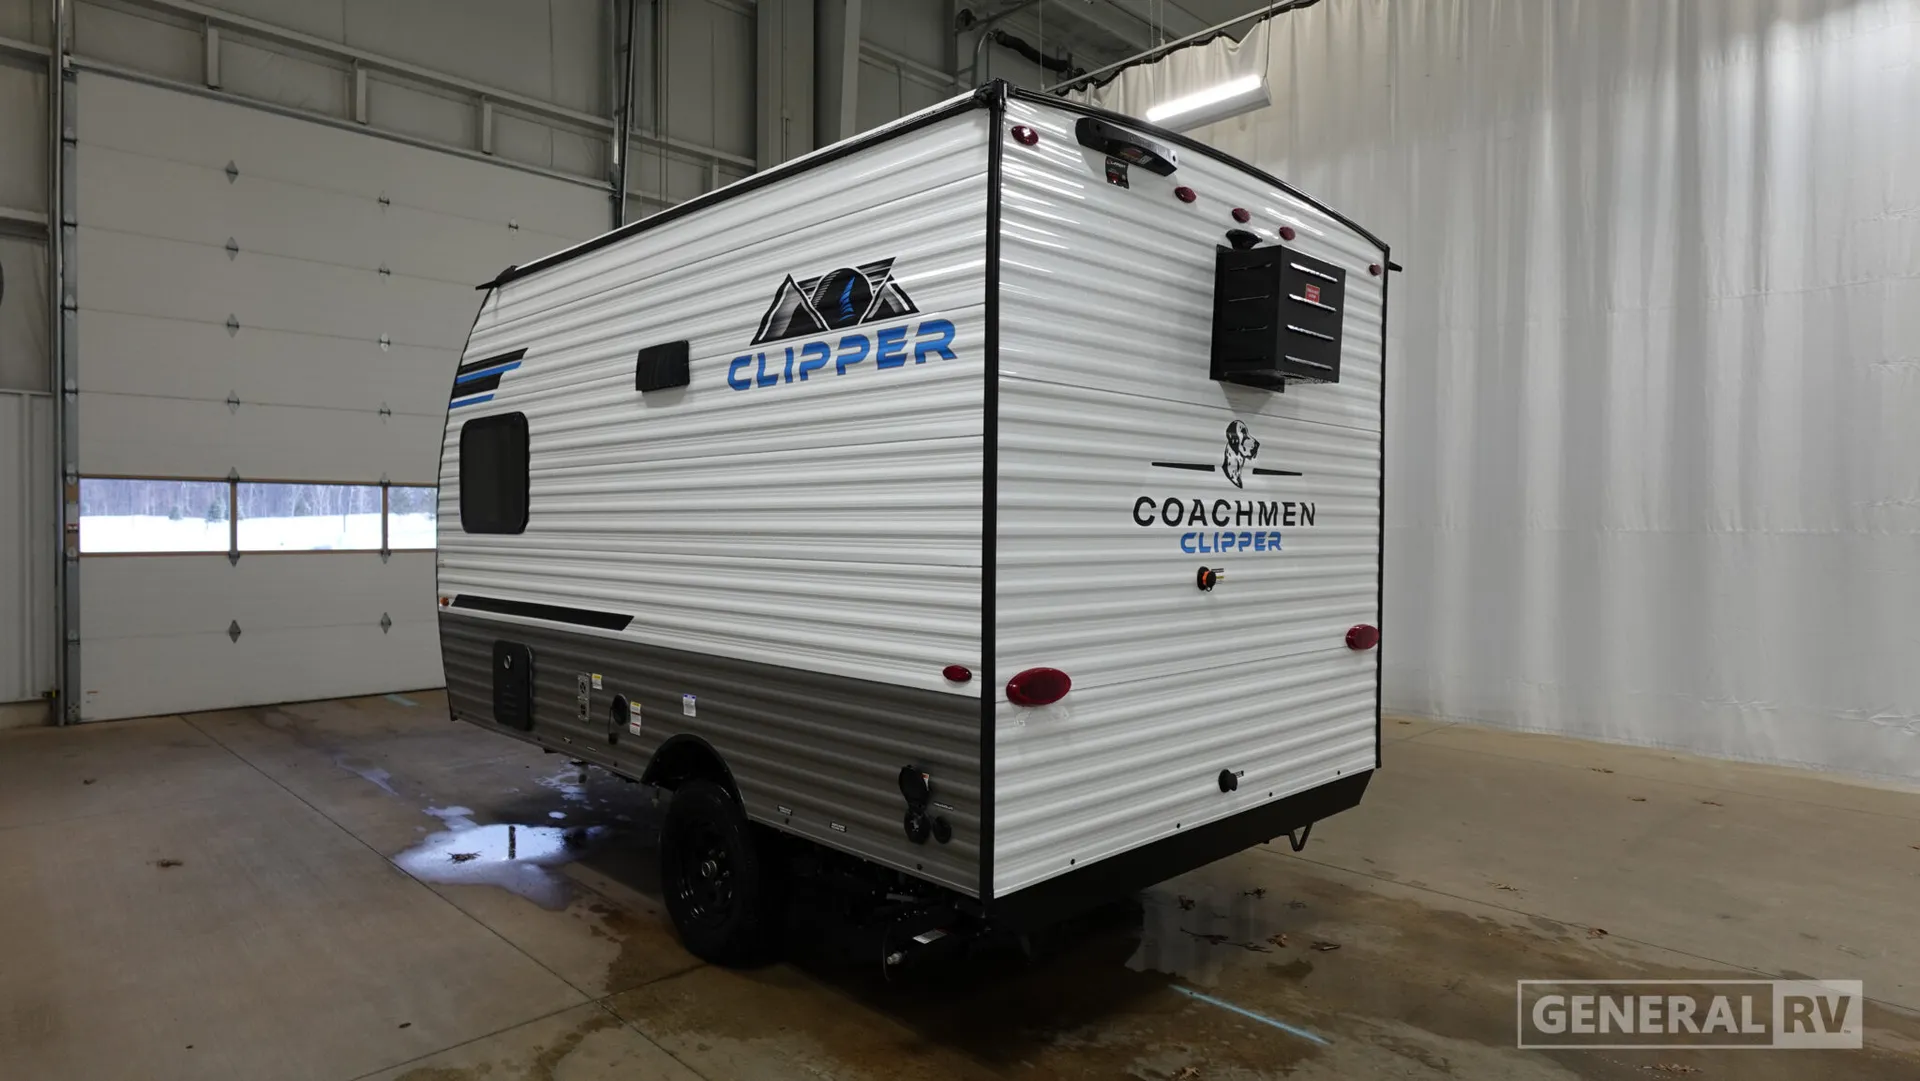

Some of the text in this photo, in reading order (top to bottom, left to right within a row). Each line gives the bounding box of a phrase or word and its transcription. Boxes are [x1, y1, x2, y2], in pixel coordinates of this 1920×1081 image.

[728, 318, 958, 391] CLIPPER
[1132, 496, 1316, 527] COACHMEN
[1180, 531, 1283, 554] CLIPPER
